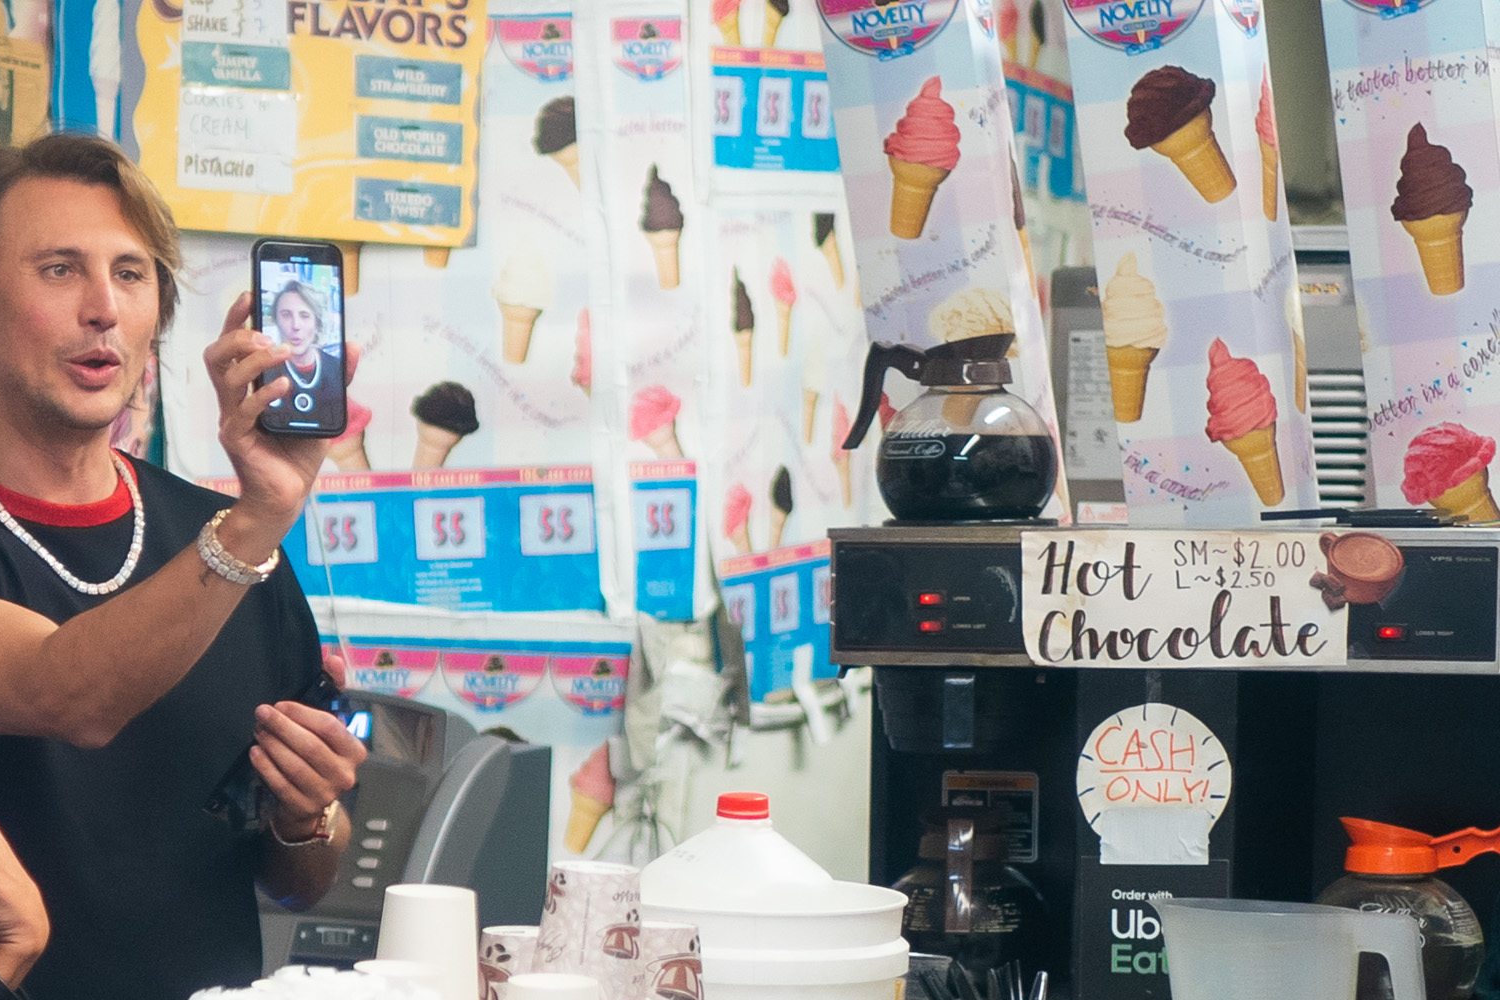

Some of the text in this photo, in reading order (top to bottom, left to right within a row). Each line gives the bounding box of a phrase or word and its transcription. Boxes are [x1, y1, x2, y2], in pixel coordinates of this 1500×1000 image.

[186, 15, 229, 33] SHAKE
[285, 1, 469, 48] FLAVORS
[850, 3, 926, 35] NOVELTY
[1099, 0, 1173, 28] NOVELTY
[622, 41, 672, 60] NOVELTY
[211, 68, 263, 83] VANILLA
[392, 68, 427, 82] WILD
[1405, 55, 1468, 83] better
[369, 79, 448, 98] STRAWBERRY
[189, 114, 250, 140] CREAM
[373, 127, 448, 145] OLD WORLD
[374, 140, 448, 158] CHOCOLATE
[184, 154, 255, 179] PISTACHIO
[384, 190, 435, 208] TUXEDO
[390, 204, 428, 219] TWIST
[1448, 372, 1461, 389] a
[1037, 540, 1153, 600] Hot
[1038, 589, 1329, 663] Chocolate
[1095, 725, 1196, 771] CASH
[1106, 776, 1210, 804] ONLY!
[1111, 888, 1173, 901] Order with
[1110, 908, 1162, 940] Ub
[1110, 943, 1169, 975] Eat
